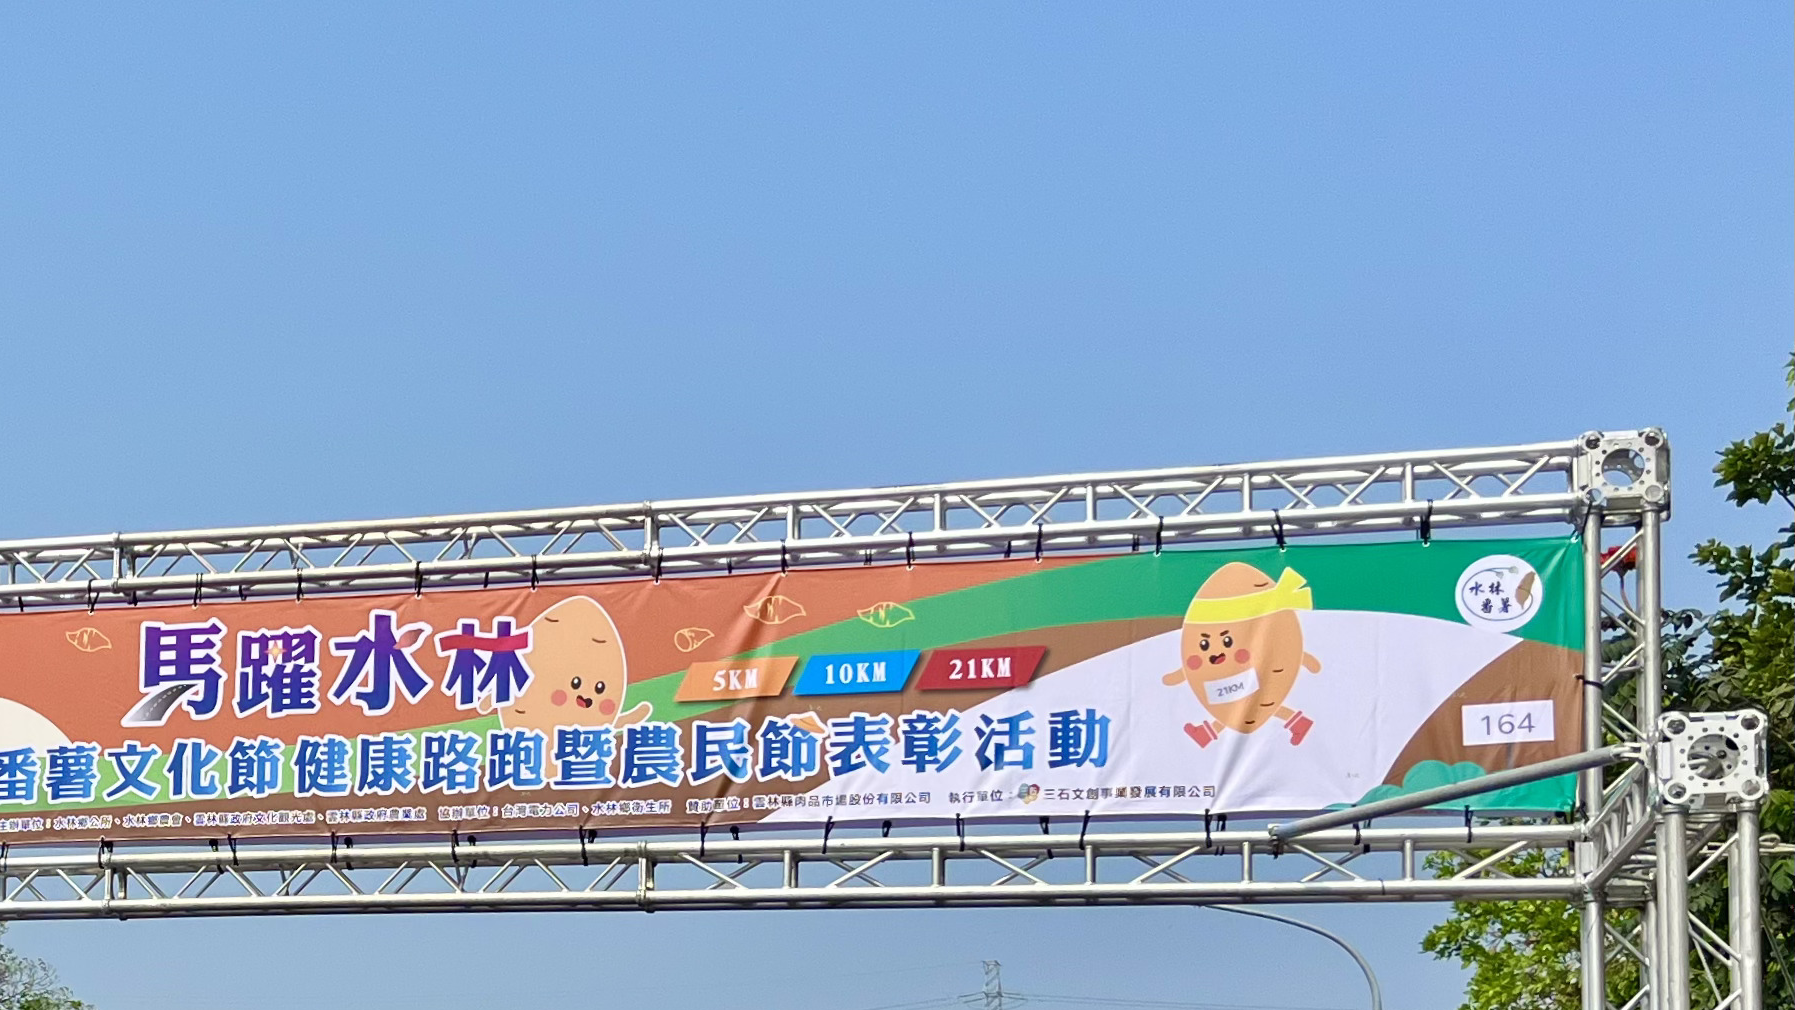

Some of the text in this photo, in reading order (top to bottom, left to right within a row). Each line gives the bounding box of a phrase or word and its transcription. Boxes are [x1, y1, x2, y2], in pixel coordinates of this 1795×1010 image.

[1469, 580, 1505, 597] 水林
[123, 611, 533, 725] 馬躍水林
[712, 668, 759, 692] 5KM
[824, 661, 888, 685] 10KM
[948, 656, 1012, 681] 21KM
[1479, 712, 1537, 737] 164
